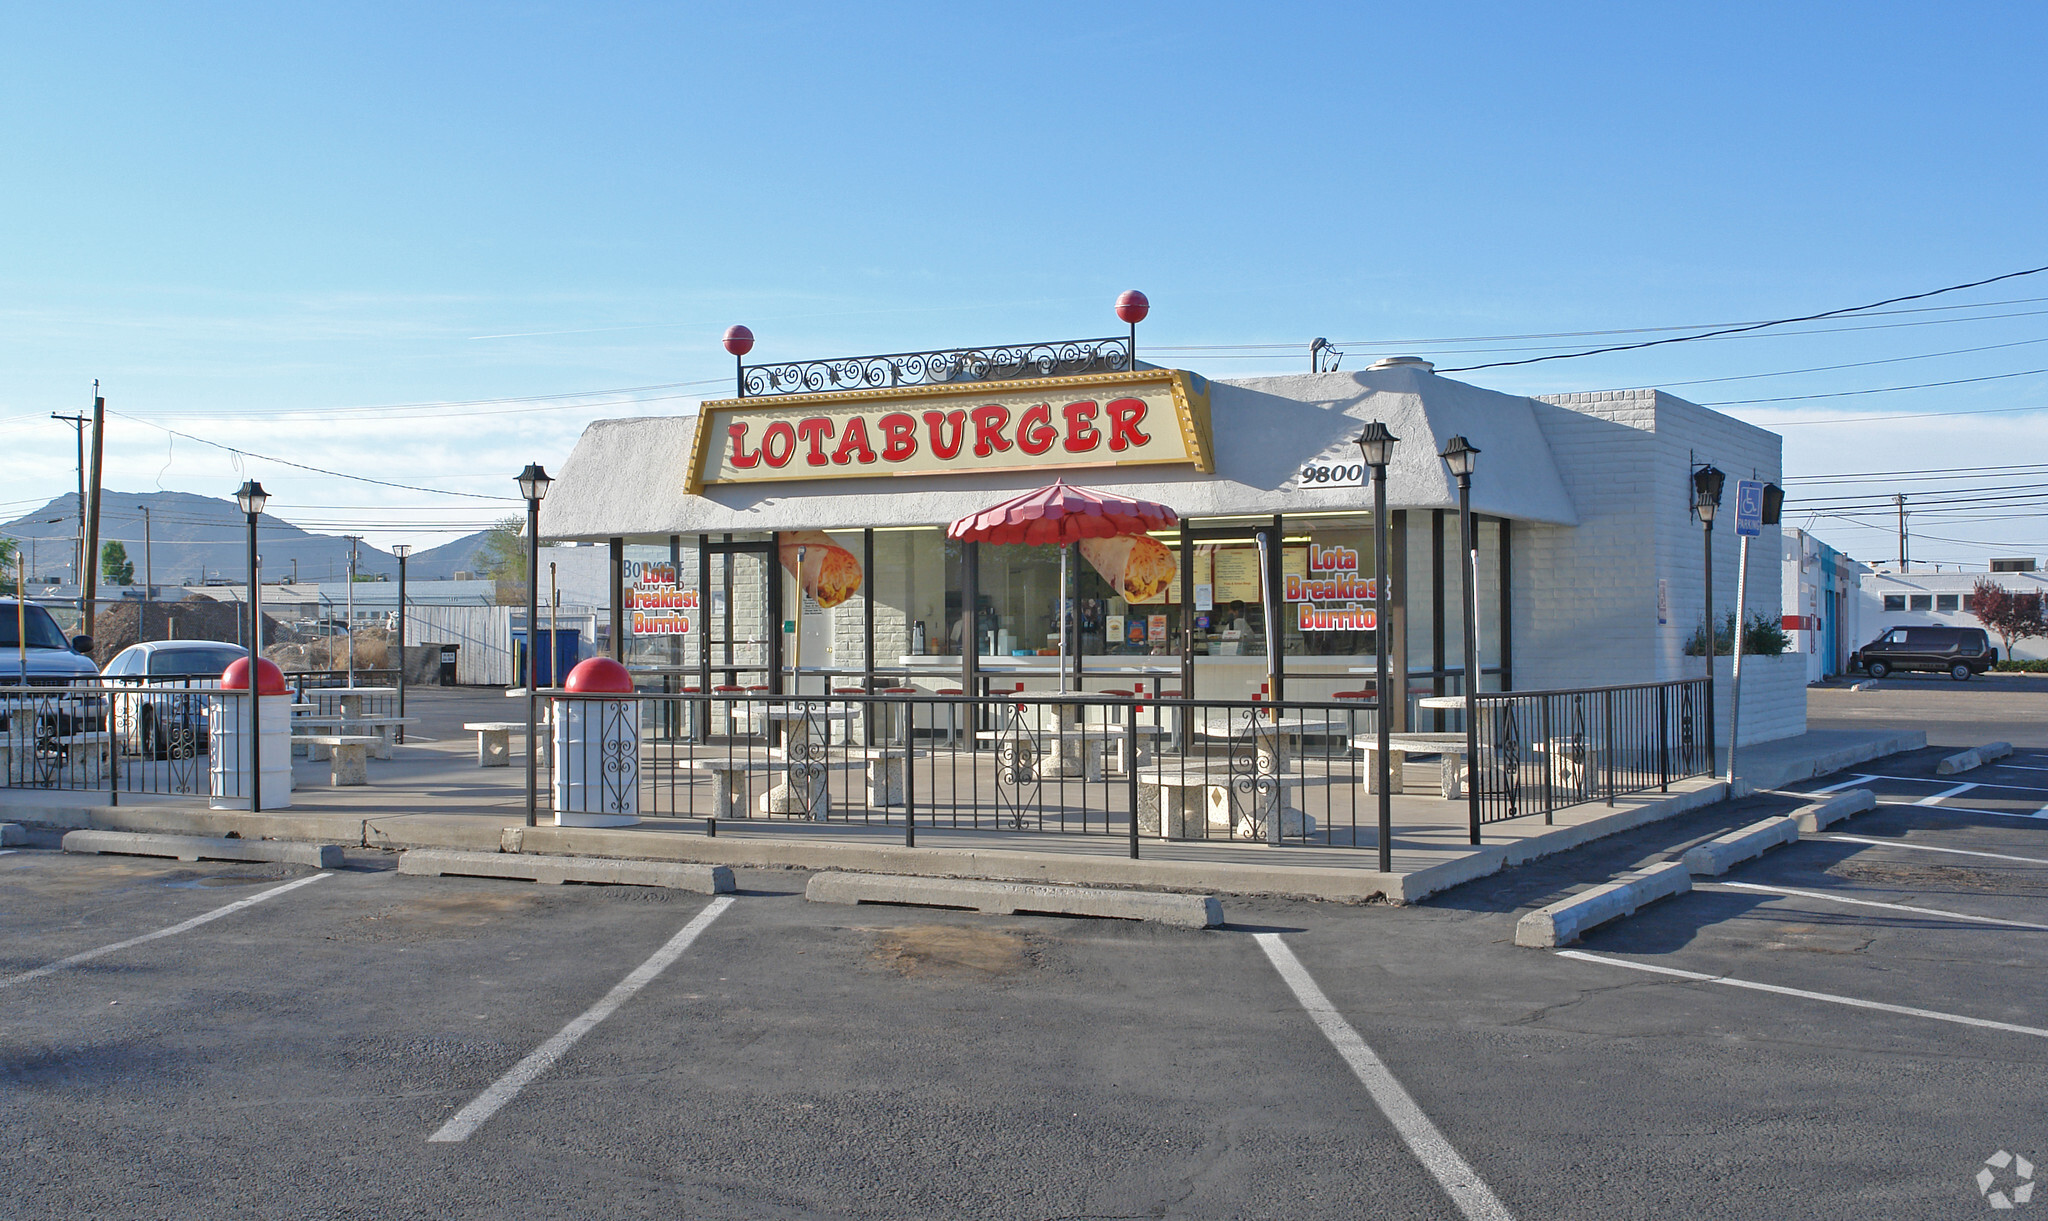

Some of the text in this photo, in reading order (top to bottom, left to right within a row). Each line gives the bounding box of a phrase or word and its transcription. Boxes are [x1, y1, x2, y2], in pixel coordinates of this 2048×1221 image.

[728, 396, 1151, 469] LOTABURGER
[1302, 464, 1363, 484] 9800
[1738, 518, 1760, 531] PARKING
[1311, 544, 1358, 571] Lota
[642, 561, 676, 584] Lota
[624, 586, 699, 609] Breakfast
[1285, 573, 1391, 602] Breakfas
[633, 611, 690, 634] Burrito
[1298, 602, 1377, 630] Burrito
